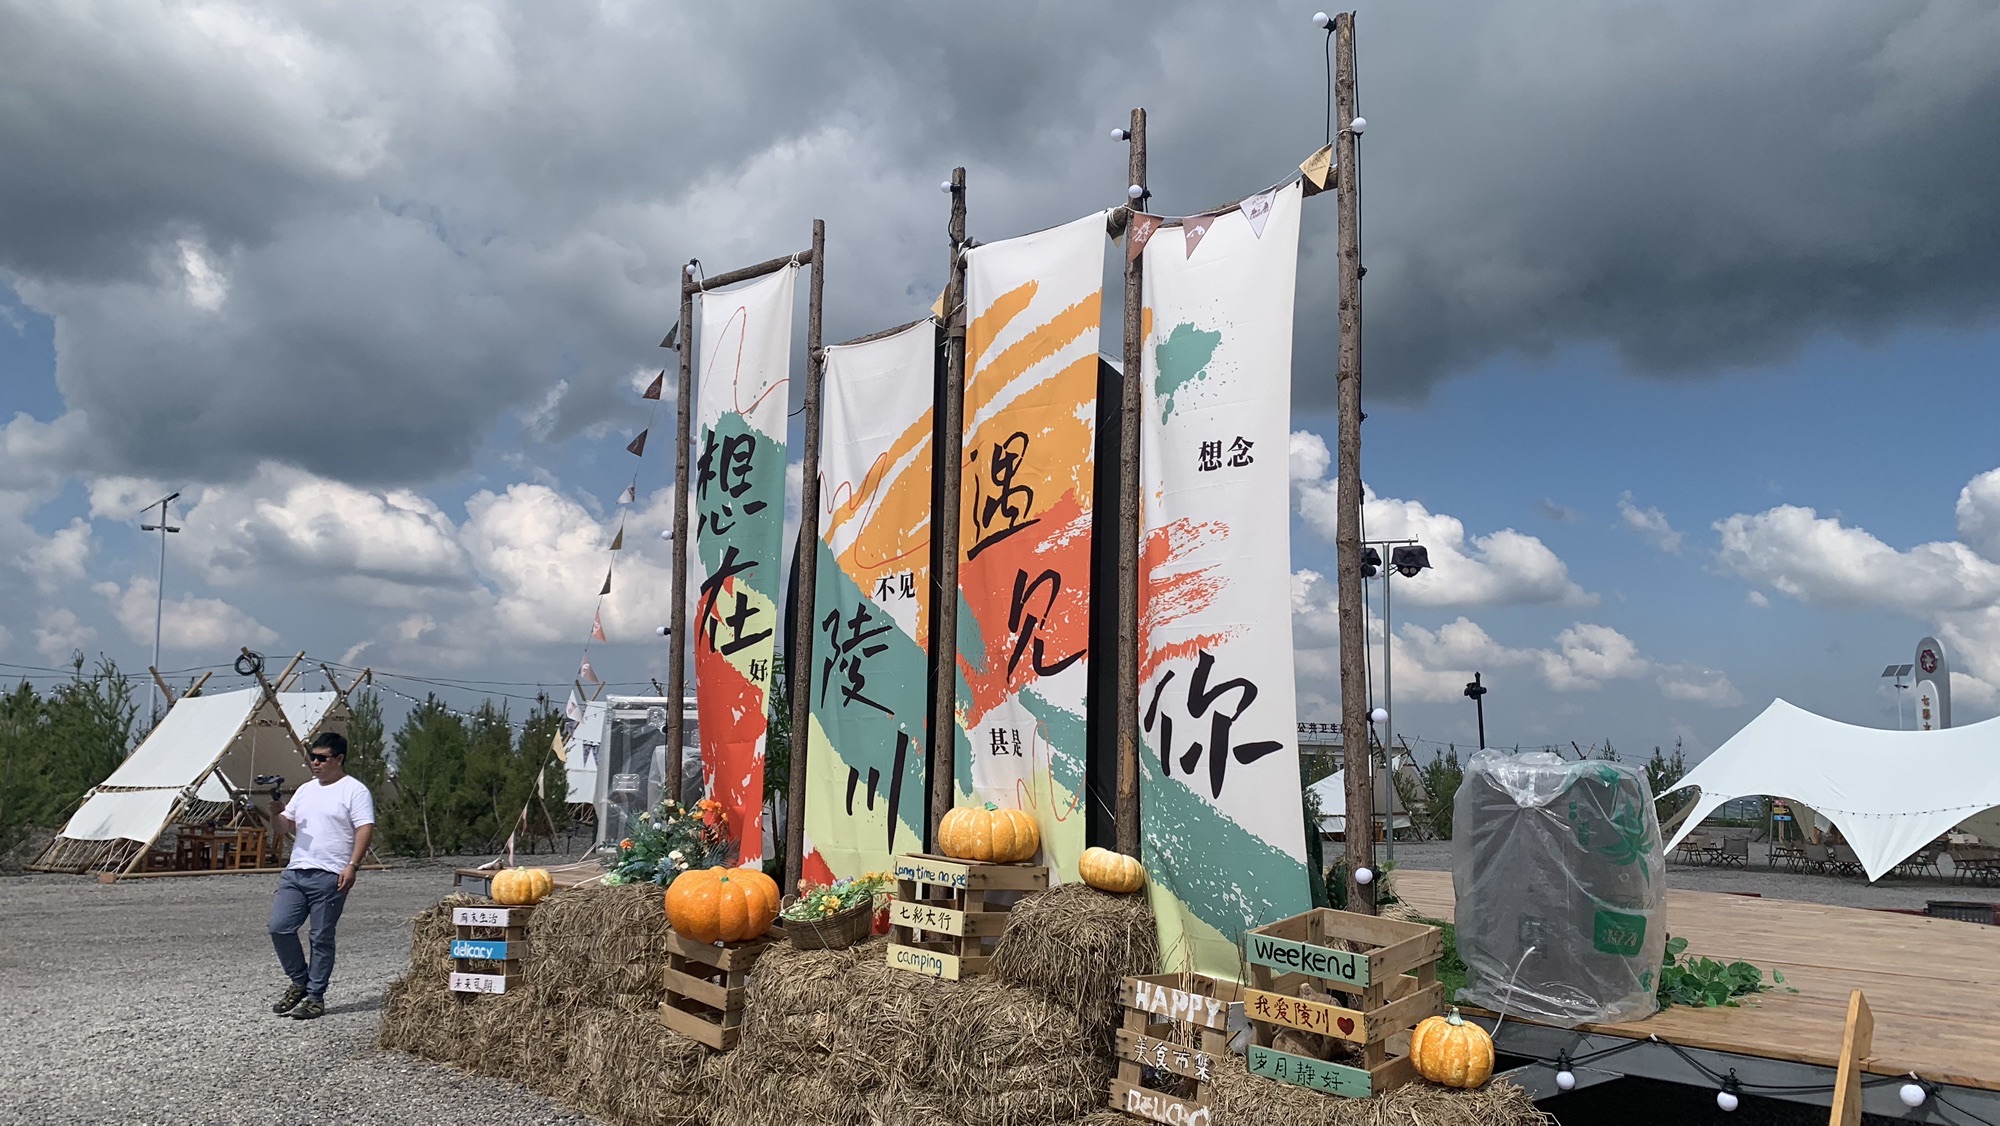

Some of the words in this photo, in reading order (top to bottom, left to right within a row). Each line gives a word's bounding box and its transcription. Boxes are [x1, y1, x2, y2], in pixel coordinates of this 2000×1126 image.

[1198, 436, 1255, 472] 想念
[967, 431, 1087, 684] 遇见
[875, 573, 916, 601] 不见
[989, 727, 1022, 757] 甚是
[1144, 649, 1284, 799] 你
[916, 864, 936, 881] time
[952, 873, 966, 887] see
[453, 941, 493, 958] delicacy
[897, 951, 942, 976] camping
[1253, 938, 1356, 980] Weekend
[1135, 980, 1222, 1028] HAPPY
[1254, 995, 1330, 1034] 我爱陵川
[1133, 1035, 1211, 1081] 美食市集
[1253, 1052, 1343, 1091] 岁月静好
